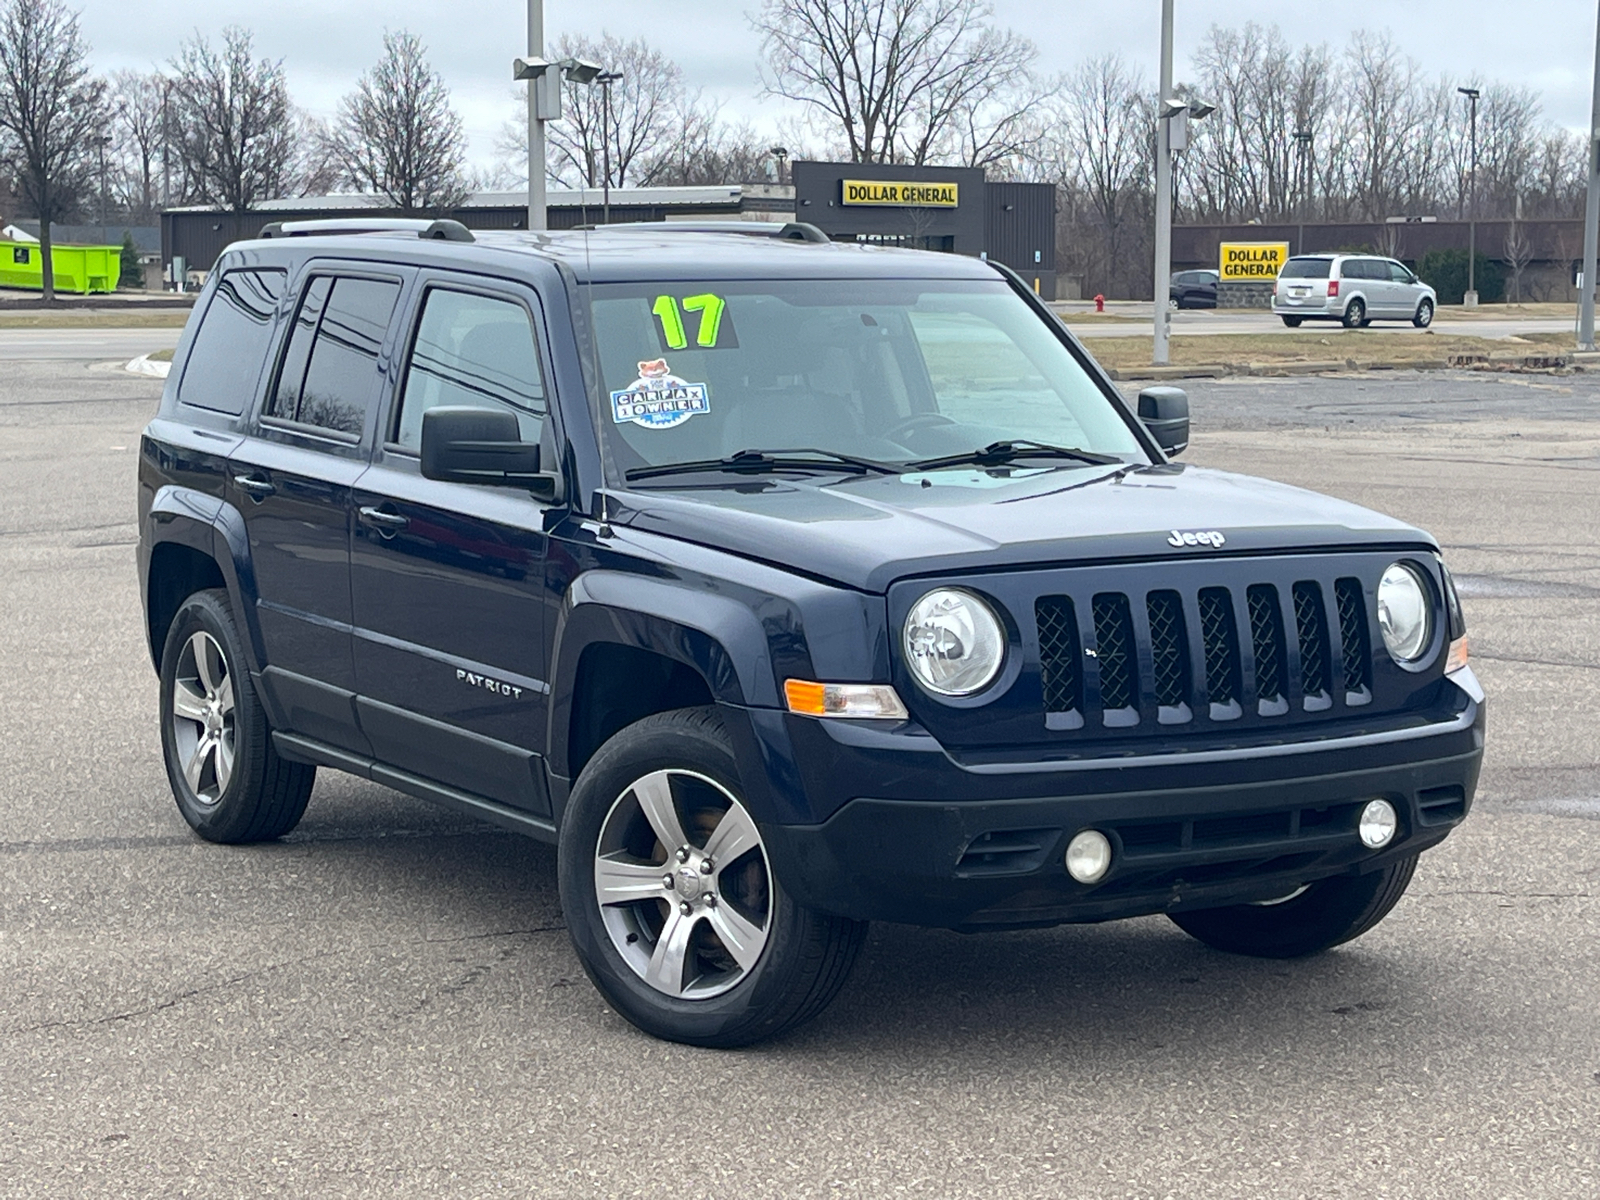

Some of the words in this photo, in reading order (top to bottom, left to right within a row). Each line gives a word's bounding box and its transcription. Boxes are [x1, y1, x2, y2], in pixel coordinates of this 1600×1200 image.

[848, 185, 898, 201] DOLLAR
[901, 186, 955, 203] GENERAL
[1228, 249, 1278, 262] DOLLAR
[1225, 263, 1280, 276] GENERAL
[652, 293, 725, 349] 17
[617, 388, 700, 405] CARFAX
[633, 399, 704, 415] OWNER
[1167, 529, 1226, 548] Jeep
[456, 668, 522, 699] PATRIOT
